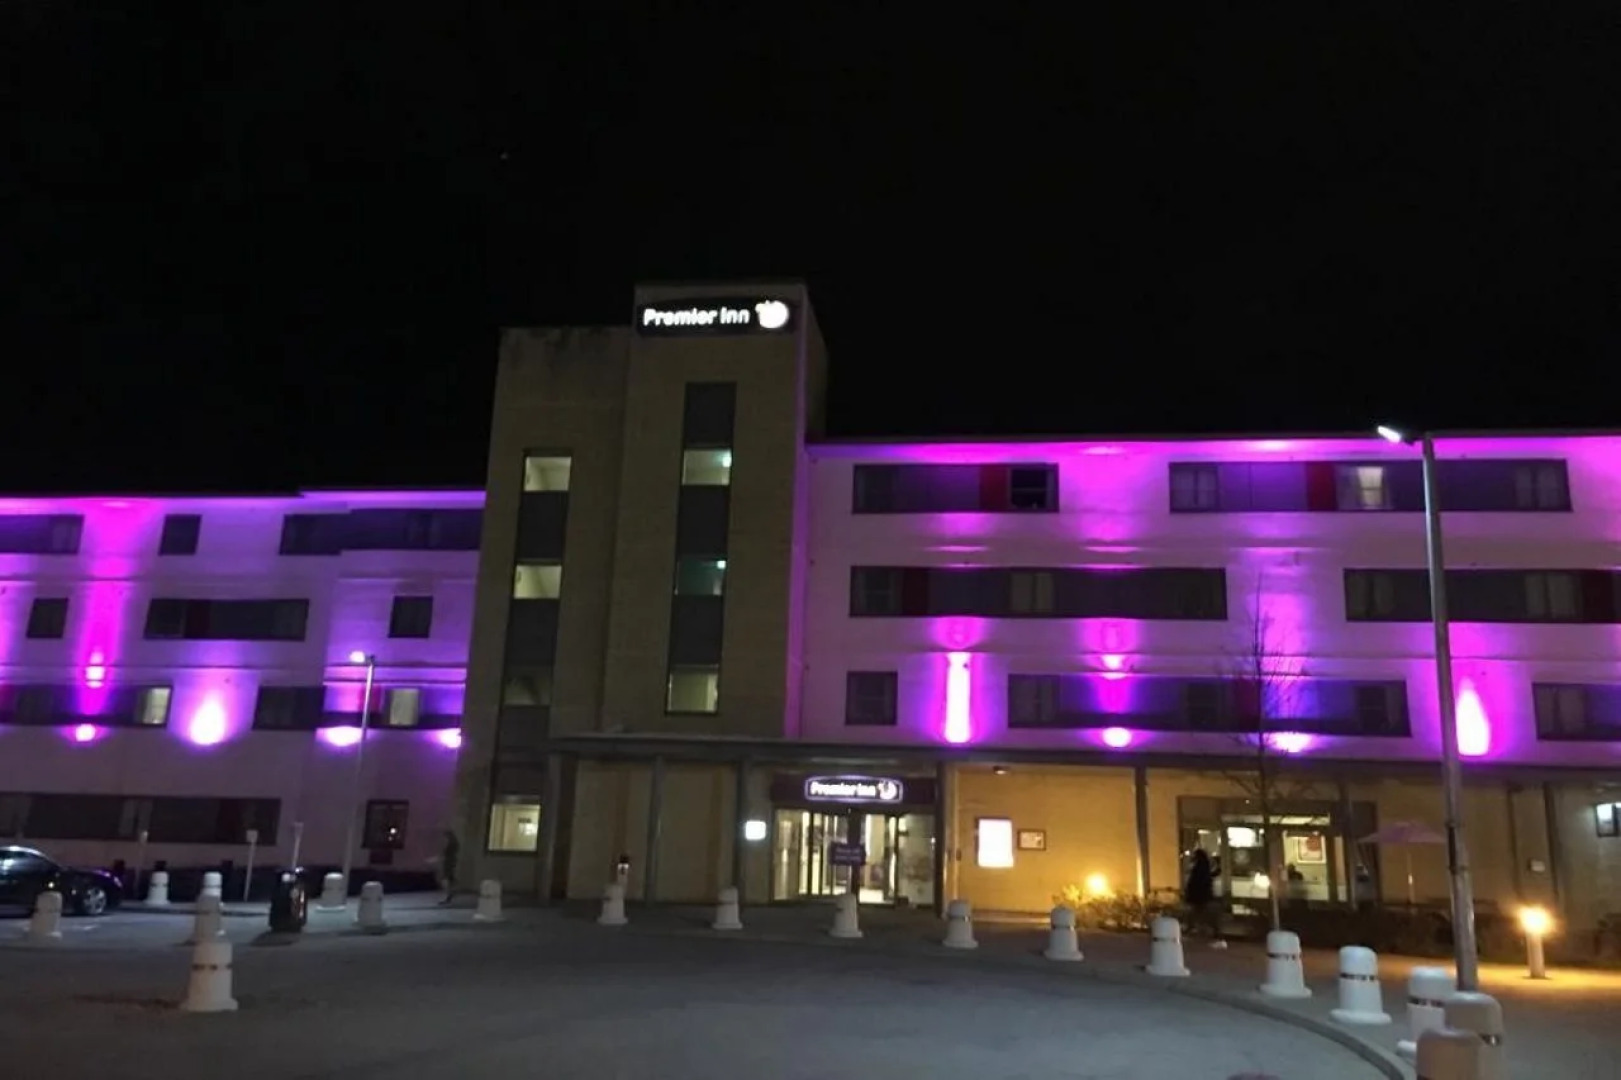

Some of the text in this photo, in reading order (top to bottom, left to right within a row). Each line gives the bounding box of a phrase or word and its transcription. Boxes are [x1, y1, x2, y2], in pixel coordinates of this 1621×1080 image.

[643, 306, 750, 326] Premier Inn
[810, 781, 856, 796] Premier
